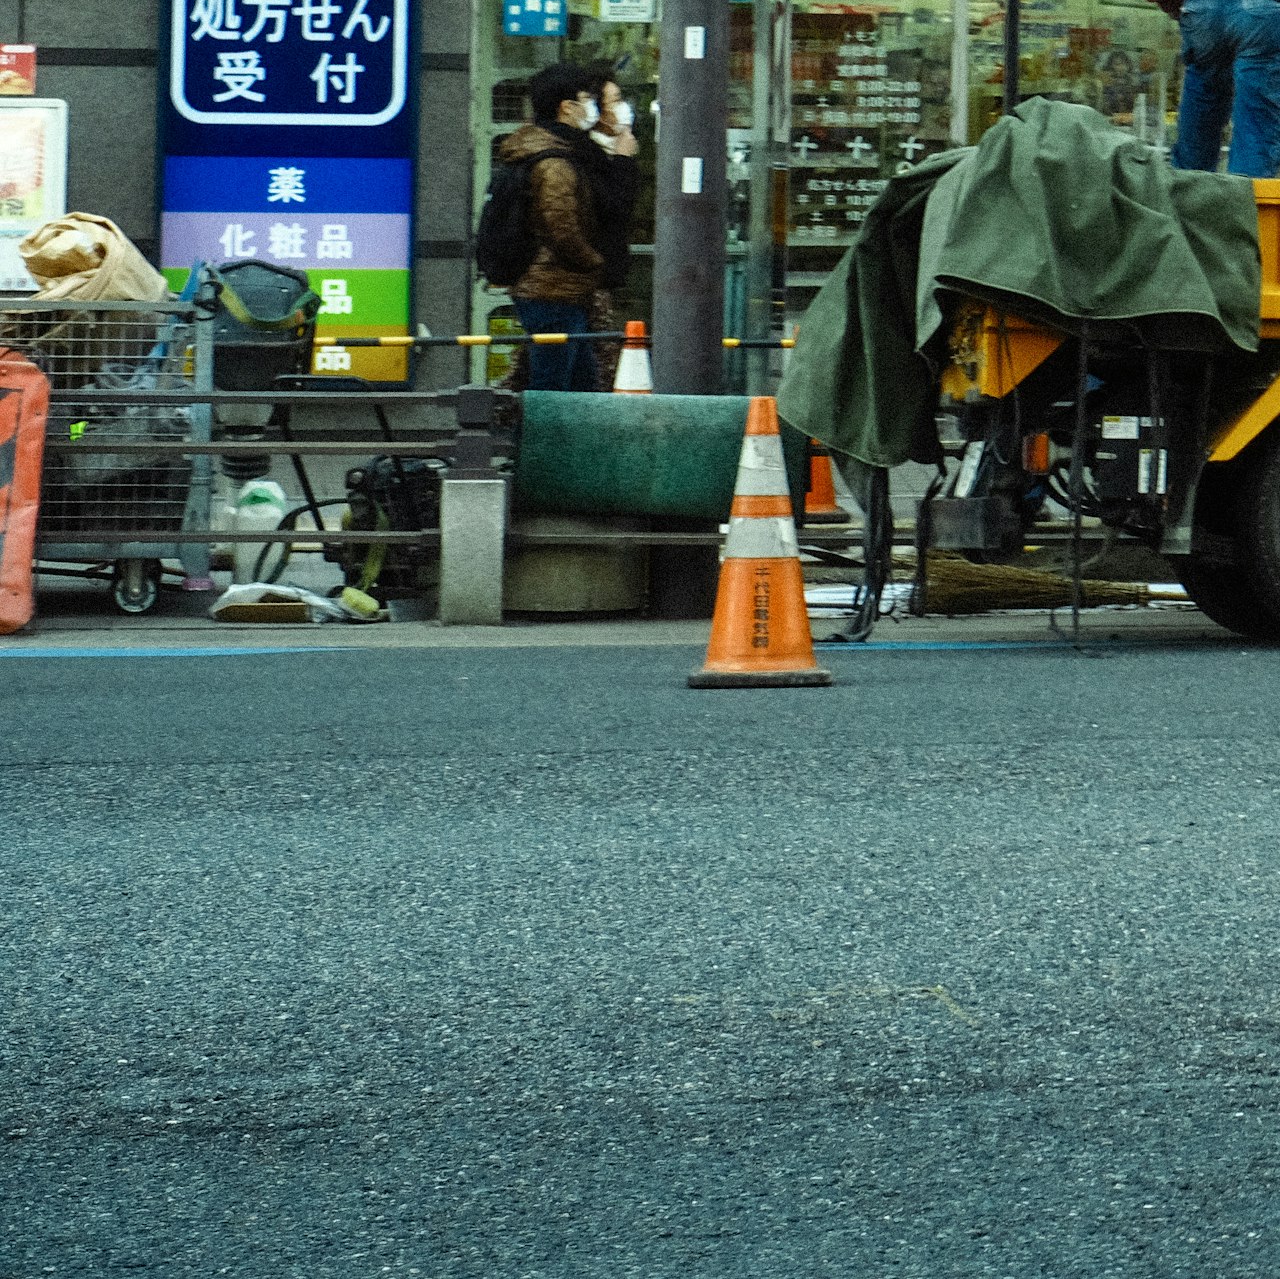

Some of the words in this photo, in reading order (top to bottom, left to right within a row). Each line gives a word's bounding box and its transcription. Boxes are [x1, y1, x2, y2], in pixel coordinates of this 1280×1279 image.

[213, 50, 366, 103] 受付
[268, 168, 306, 203] 薬
[219, 224, 353, 259] 化粧品
